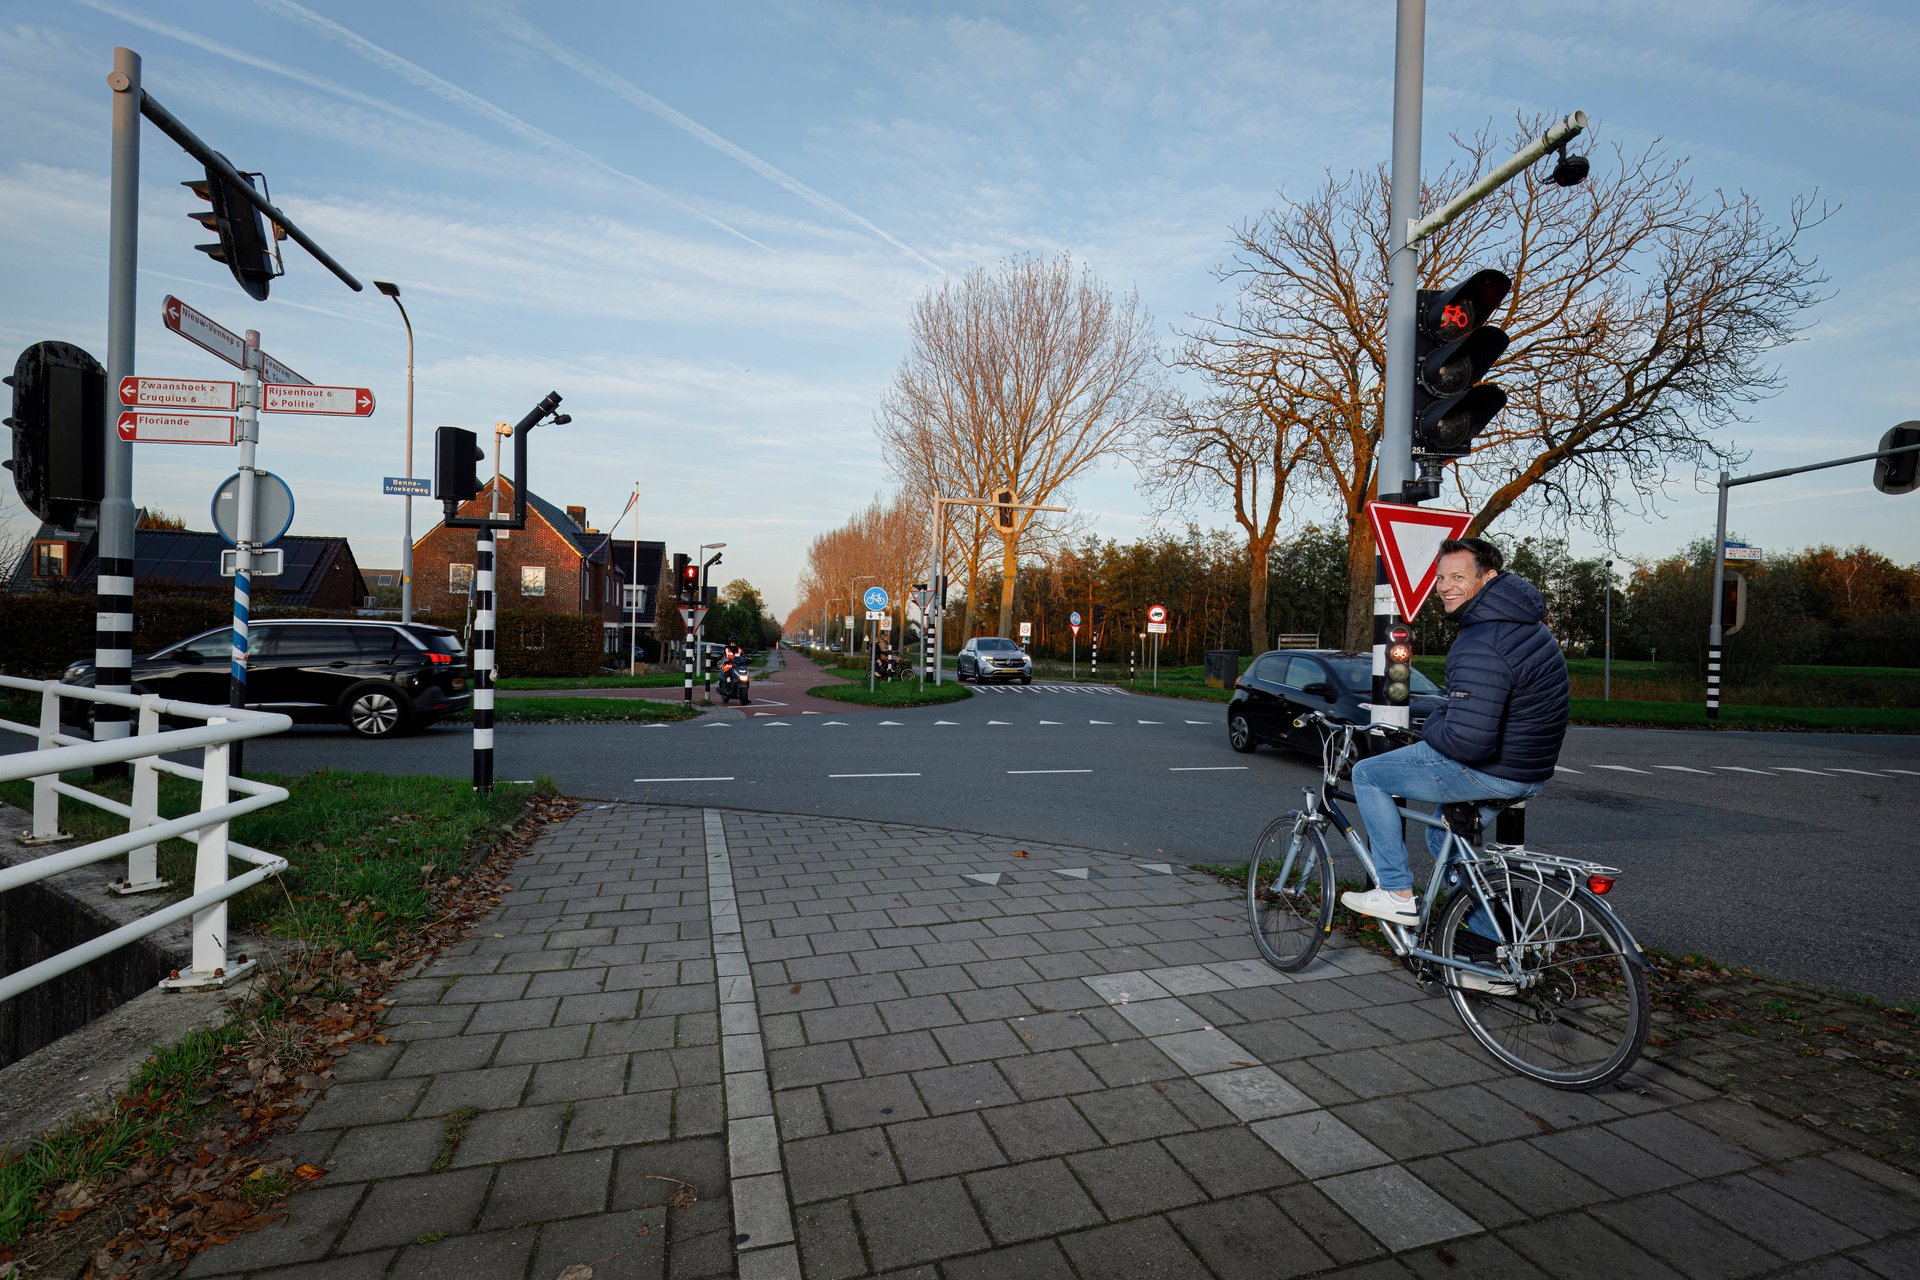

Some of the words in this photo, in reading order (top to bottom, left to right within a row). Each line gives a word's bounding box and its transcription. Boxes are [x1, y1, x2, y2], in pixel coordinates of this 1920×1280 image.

[181, 307, 235, 345] Nieuw-Vennep
[265, 358, 290, 379] Centrum
[141, 381, 207, 392] Zwaanshoek
[269, 387, 323, 397] Rijsenhout
[140, 393, 187, 403] Cruquius
[281, 399, 315, 408] Politie
[139, 416, 190, 426] Floriande
[385, 485, 429, 495] broekerweg
